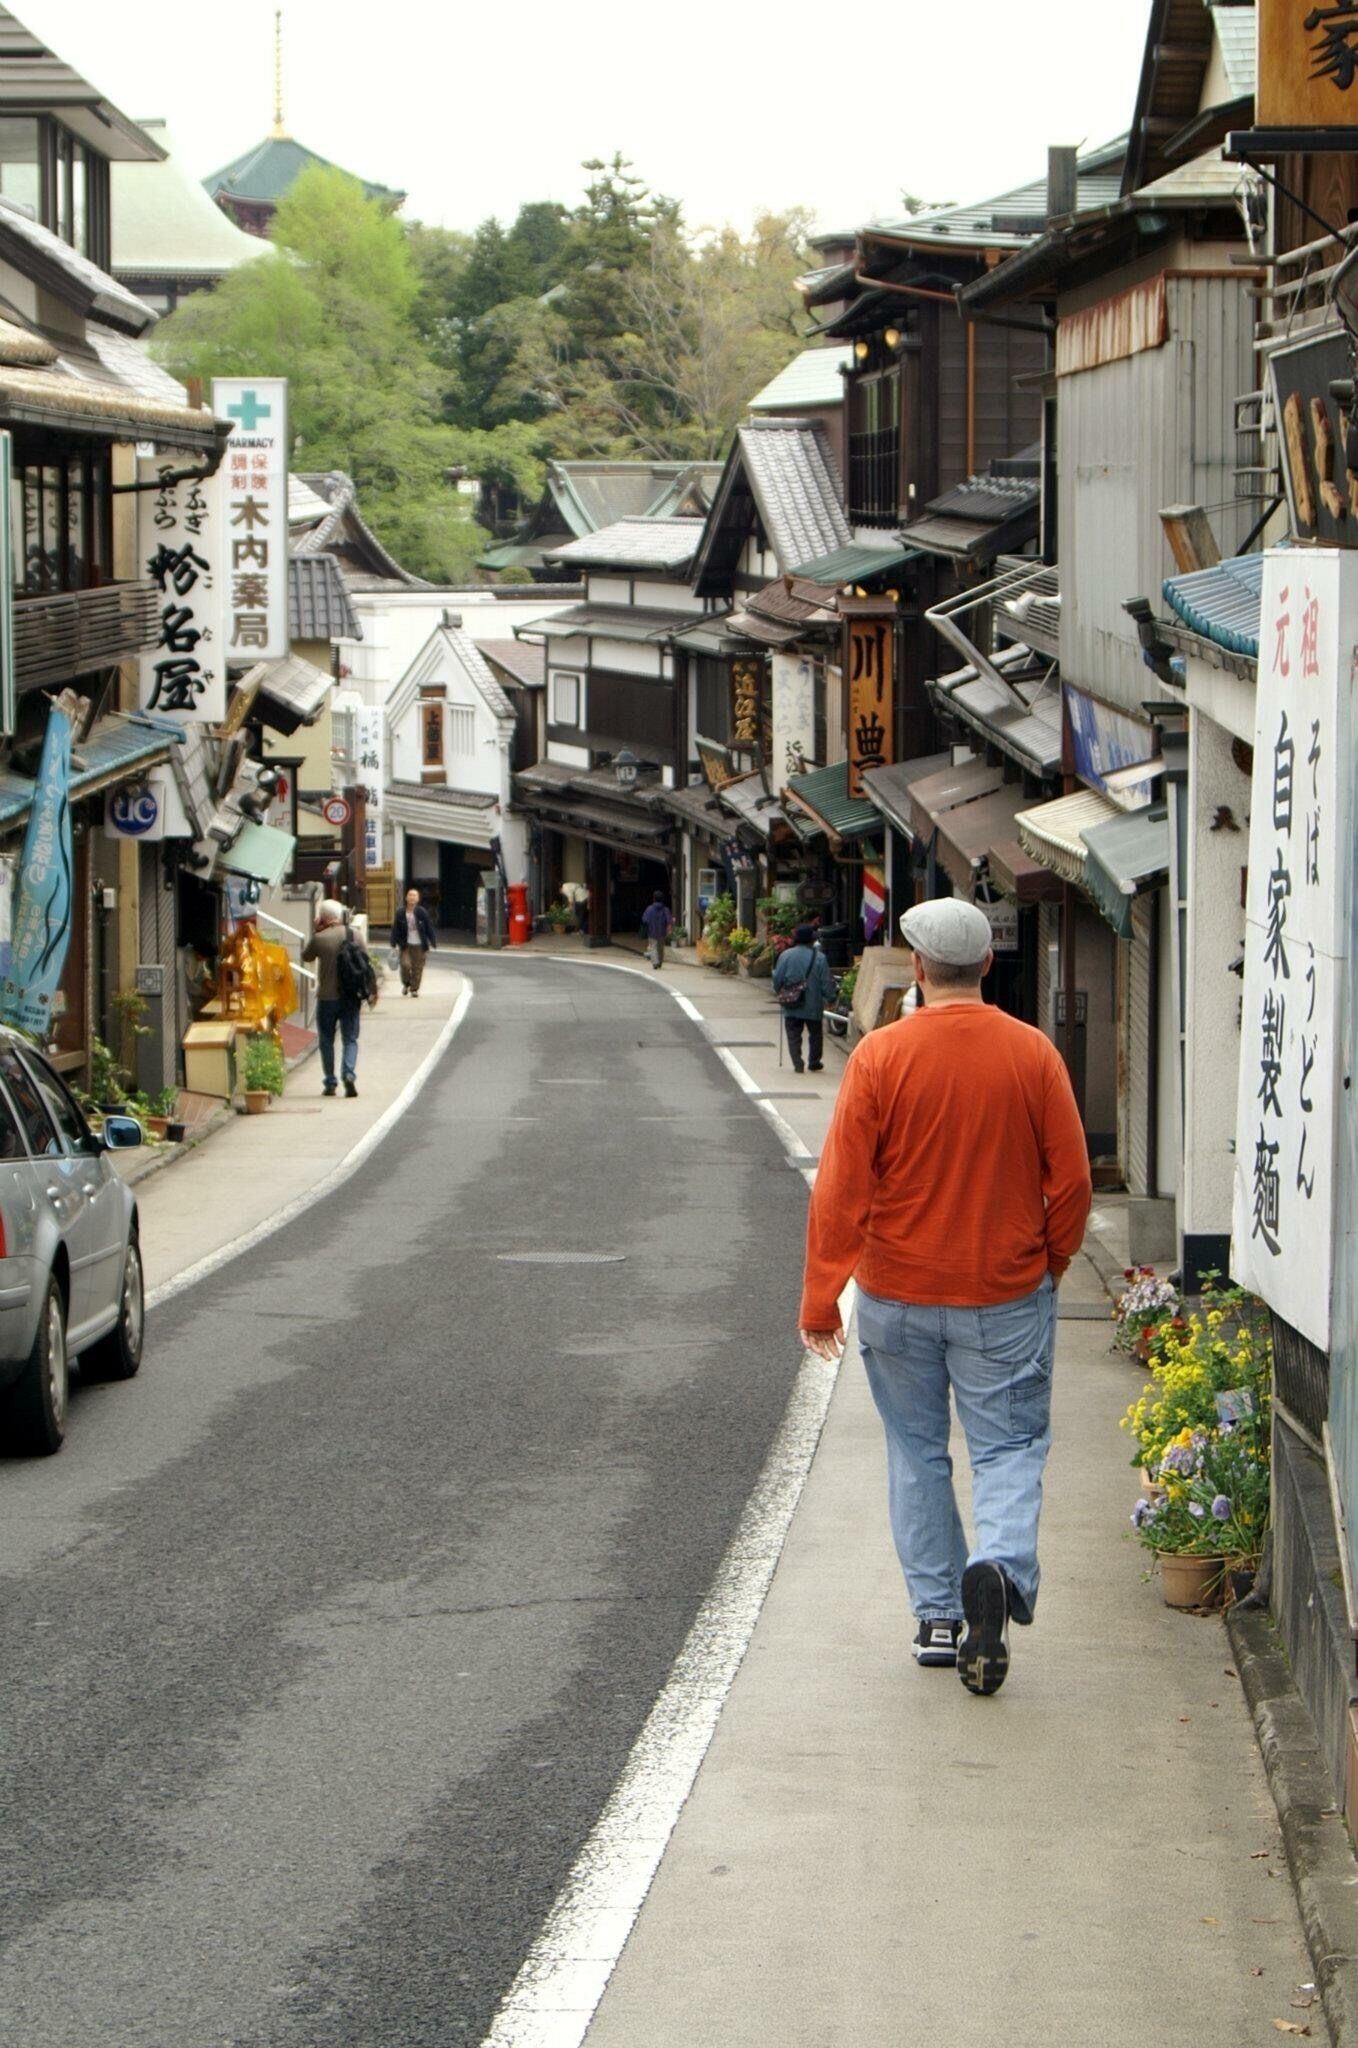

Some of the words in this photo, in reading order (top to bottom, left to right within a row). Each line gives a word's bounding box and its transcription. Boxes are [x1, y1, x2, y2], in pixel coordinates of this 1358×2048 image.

[146, 543, 211, 712] 粉名屋
[229, 496, 270, 649] 木内薬局
[330, 805, 344, 819] 20
[1296, 941, 1318, 1200] うどん
